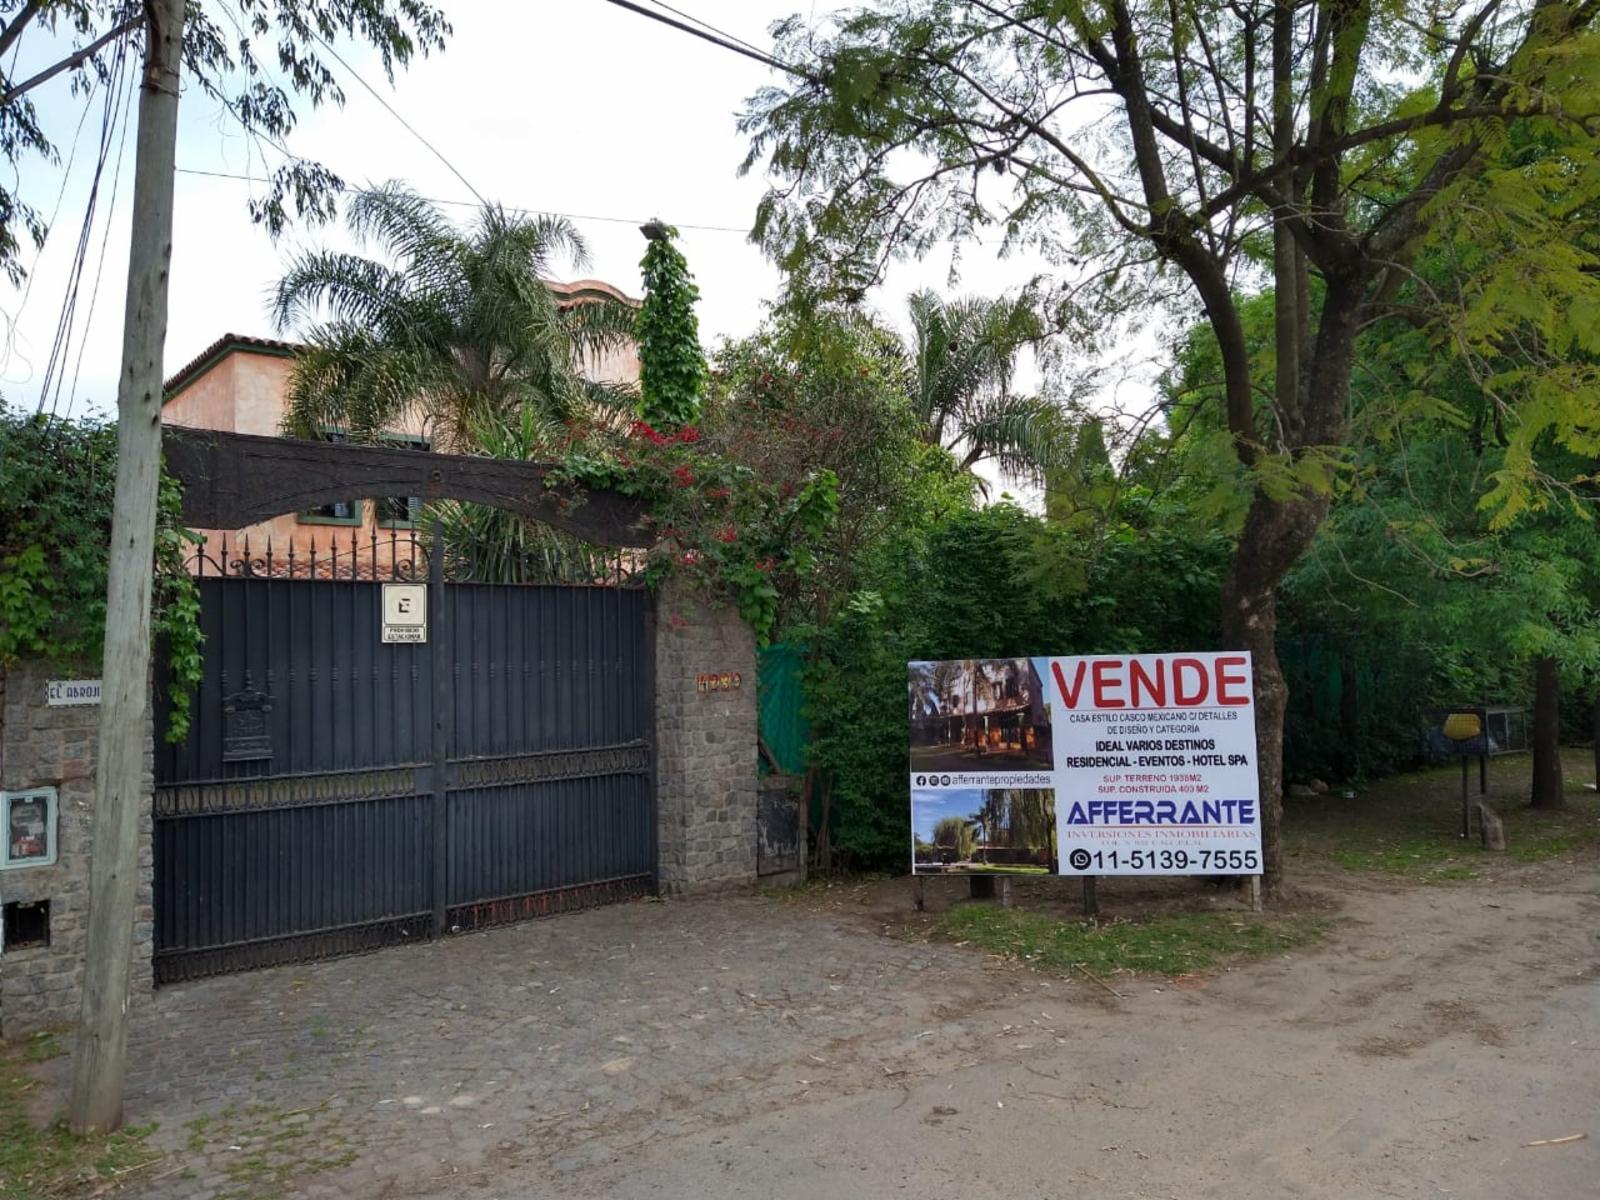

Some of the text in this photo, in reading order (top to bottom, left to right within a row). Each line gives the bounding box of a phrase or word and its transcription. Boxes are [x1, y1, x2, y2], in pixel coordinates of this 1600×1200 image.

[1051, 657, 1250, 709] VENDE
[1070, 714, 1091, 723] CASA
[1092, 713, 1118, 723] ESTILO
[1119, 713, 1146, 722] CASCO
[1147, 712, 1187, 722] MEXICANO
[1198, 711, 1237, 721] DETALLES
[1107, 725, 1119, 735] DE
[1120, 724, 1148, 735] DISEÑO
[1150, 725, 1155, 734] Y
[1096, 739, 1215, 752] IDEAL VARIOS DESTINOS
[1067, 757, 1131, 768] RESIDENCIAL
[1138, 756, 1185, 767] EVENTOS
[1192, 755, 1226, 766] HOTEL
[1228, 754, 1248, 766] SPA
[952, 774, 1051, 786] afferrantepropiedades
[1125, 774, 1167, 783] TERRENO
[1119, 785, 1177, 793] CONSTRUIDA
[1067, 800, 1255, 824] AFFERRANTE
[1067, 829, 1256, 839] INVERSIONES INMOBILIARIAS
[1093, 850, 1258, 870] 11-5139-7555
